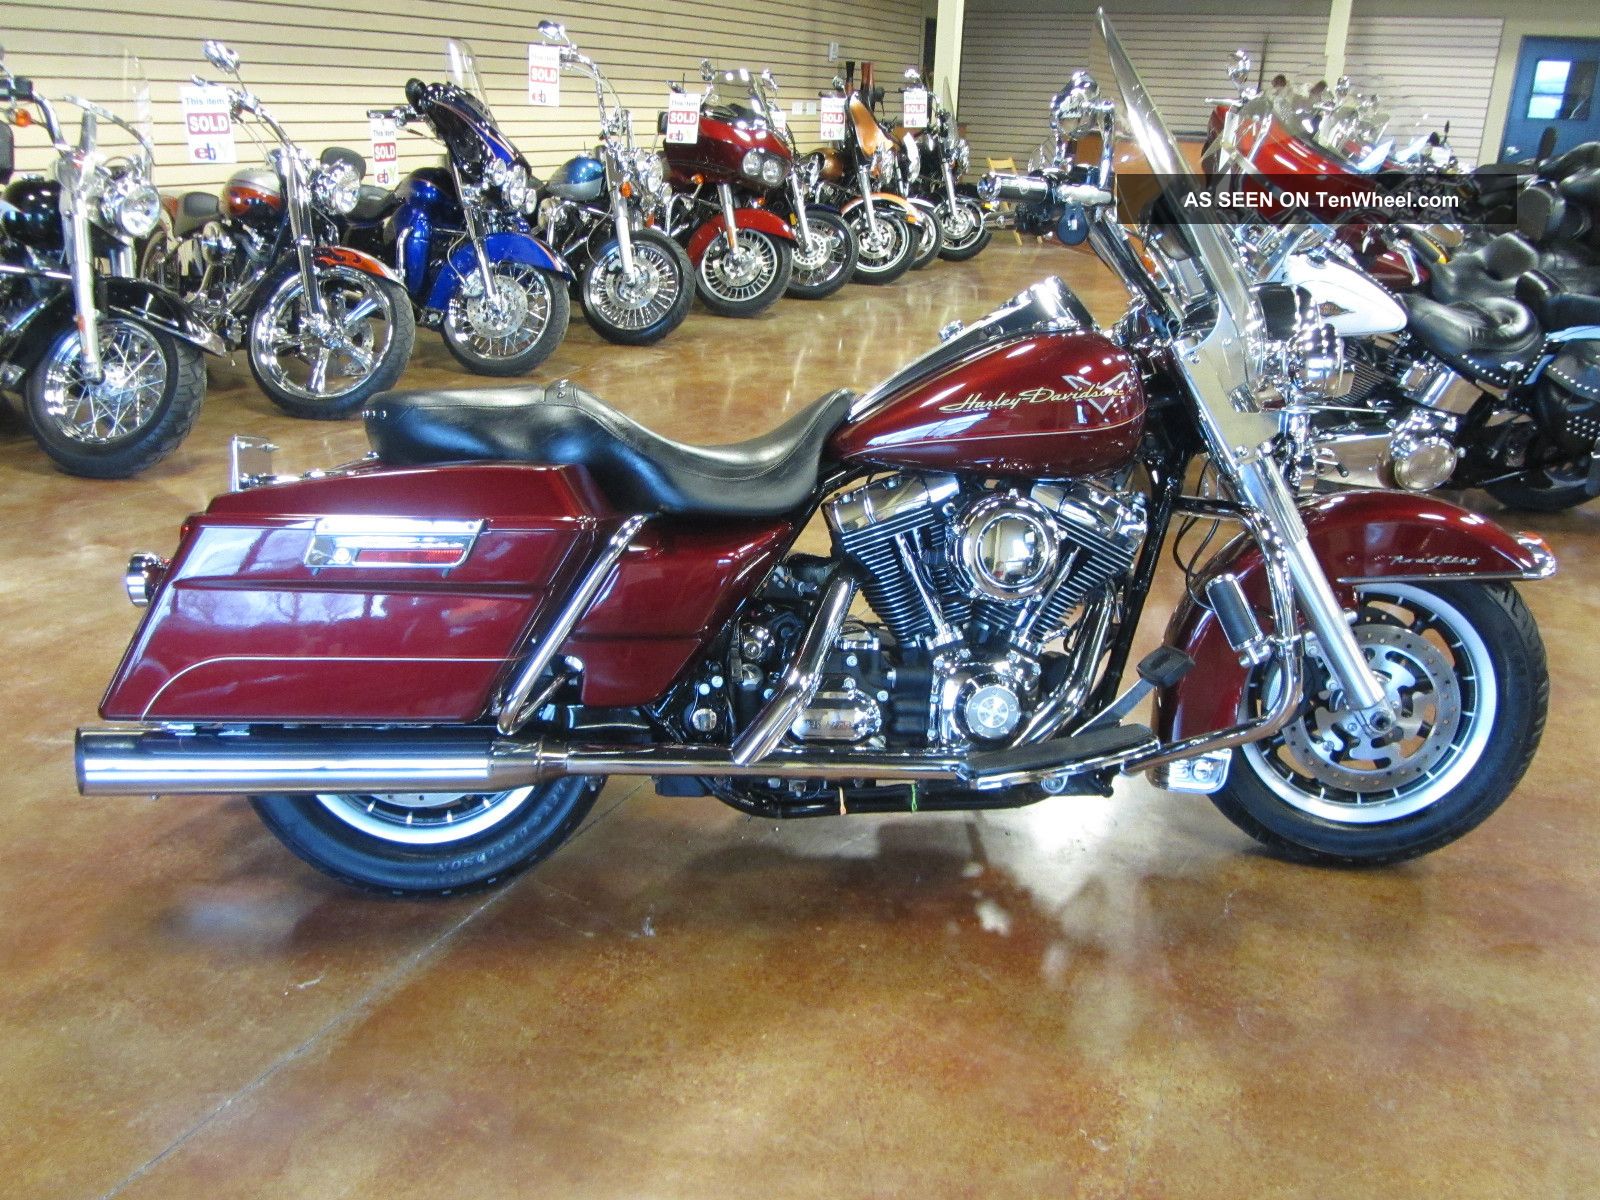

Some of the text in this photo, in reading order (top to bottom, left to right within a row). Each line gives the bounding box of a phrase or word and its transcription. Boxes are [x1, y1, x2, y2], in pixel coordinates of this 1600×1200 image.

[532, 67, 557, 83] SOLD
[185, 95, 226, 106] This item
[189, 114, 229, 133] SOLD
[669, 112, 697, 124] SOLD
[822, 112, 843, 123] SOLD
[374, 144, 395, 160] SOLD
[938, 383, 1124, 413] Harley-Davidson
